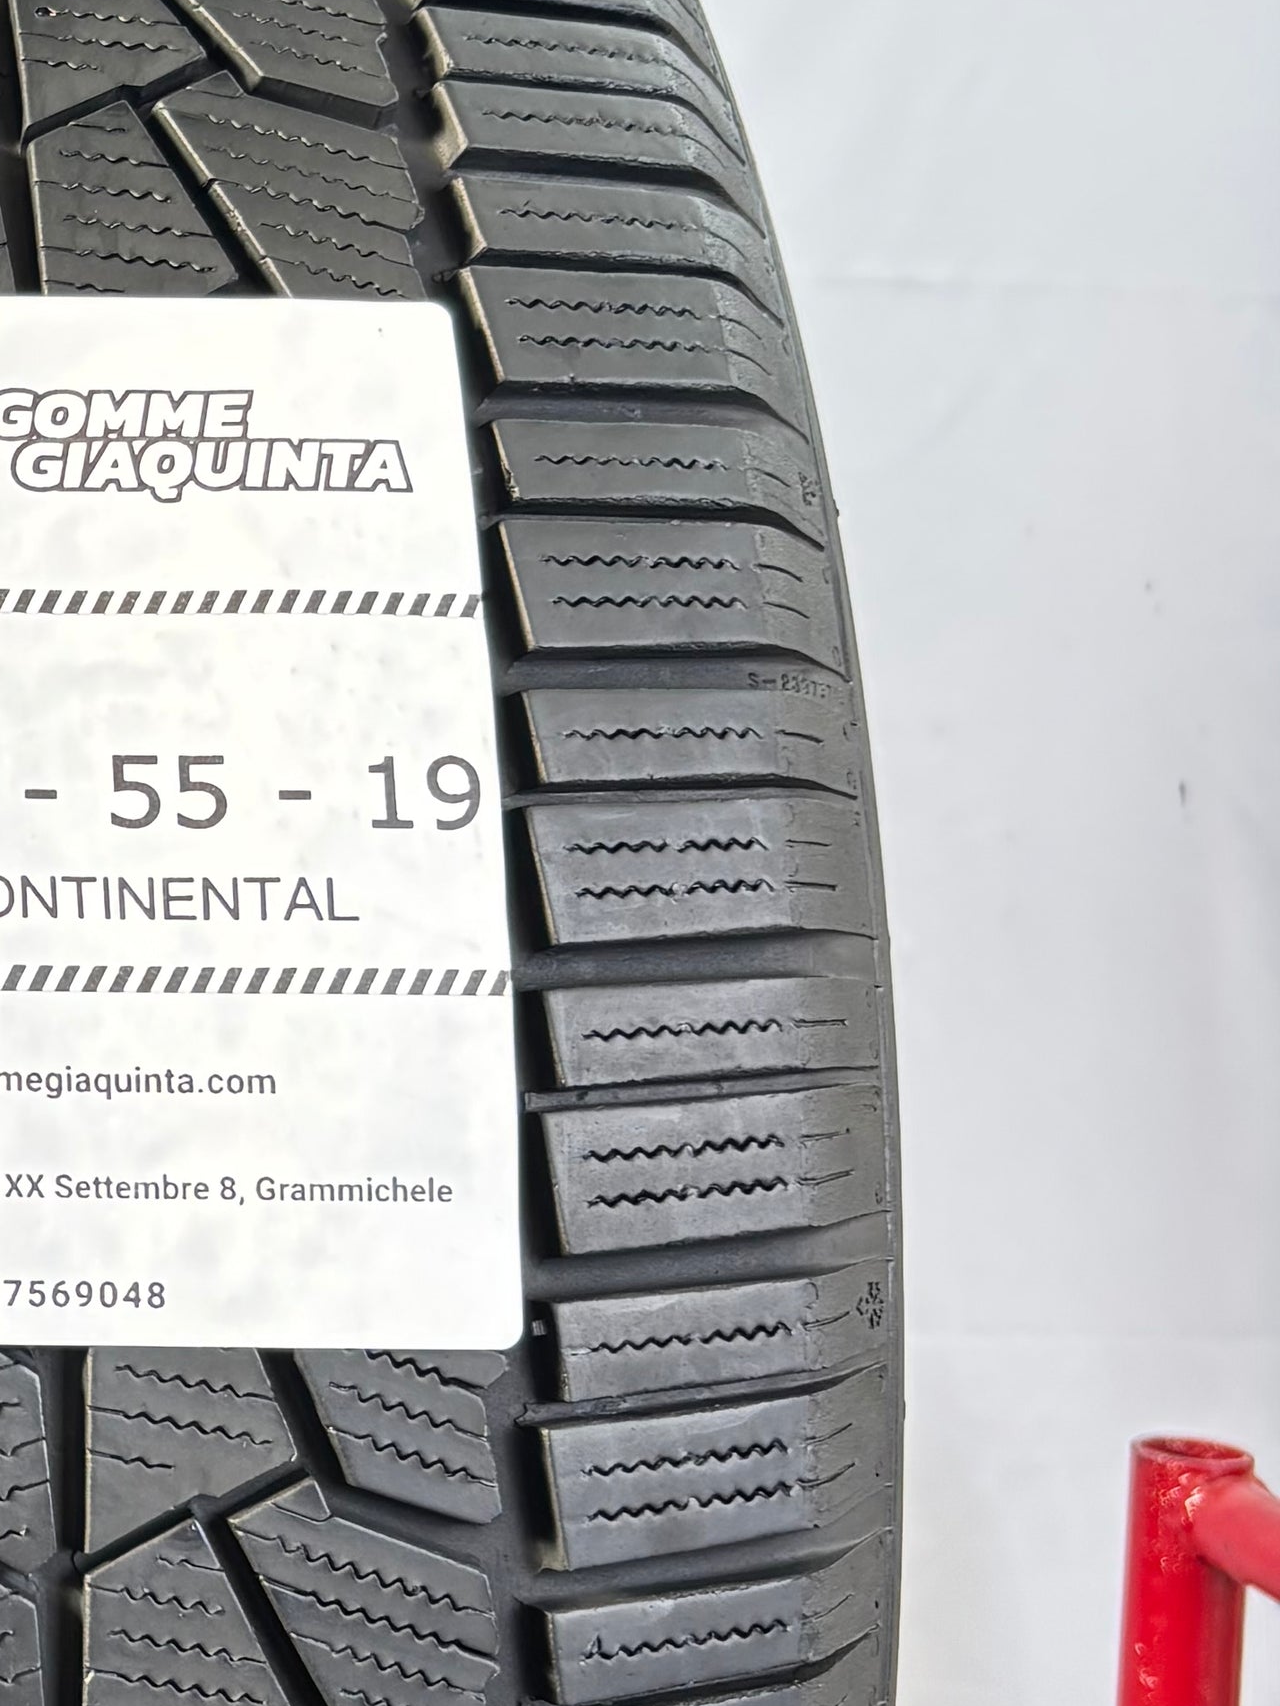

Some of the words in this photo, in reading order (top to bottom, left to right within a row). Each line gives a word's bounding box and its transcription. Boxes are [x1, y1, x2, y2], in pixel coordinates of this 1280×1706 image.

[11, 434, 414, 504] GIAQUINTA
[110, 754, 228, 830] 55
[368, 755, 481, 831] 19
[5, 1173, 45, 1199] XX
[55, 1173, 210, 1200] Settembre
[220, 1176, 245, 1206] 8,
[256, 1176, 453, 1203] Grammichele
